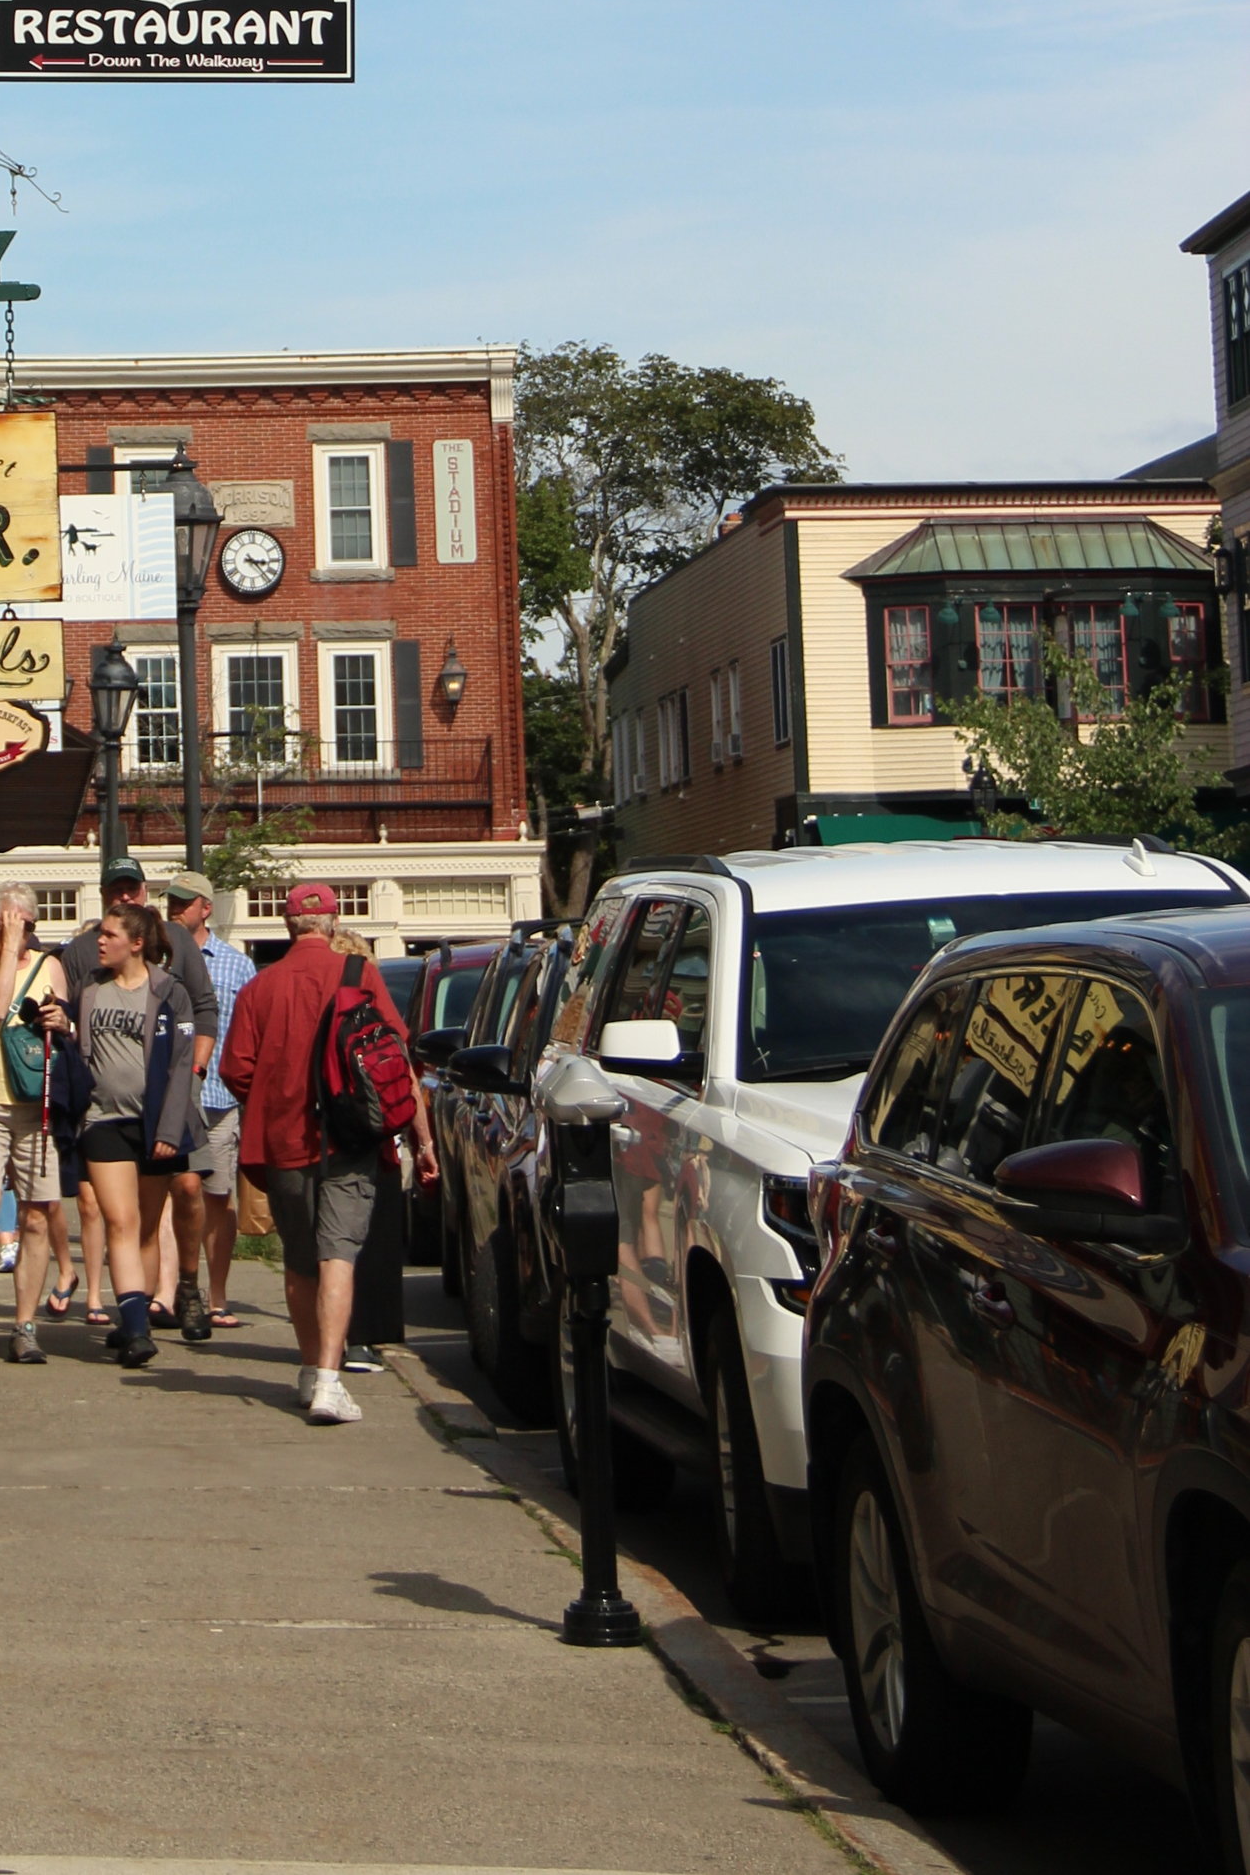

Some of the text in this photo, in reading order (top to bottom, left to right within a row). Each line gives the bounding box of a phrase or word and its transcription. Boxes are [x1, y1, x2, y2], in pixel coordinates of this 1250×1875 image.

[13, 9, 333, 46] RESTAURANT
[88, 53, 264, 72] Down The Walkway
[441, 443, 464, 453] THE
[447, 456, 464, 559] STADIUM
[62, 559, 163, 591] arling Maine
[75, 593, 126, 604] BOUTIQUE
